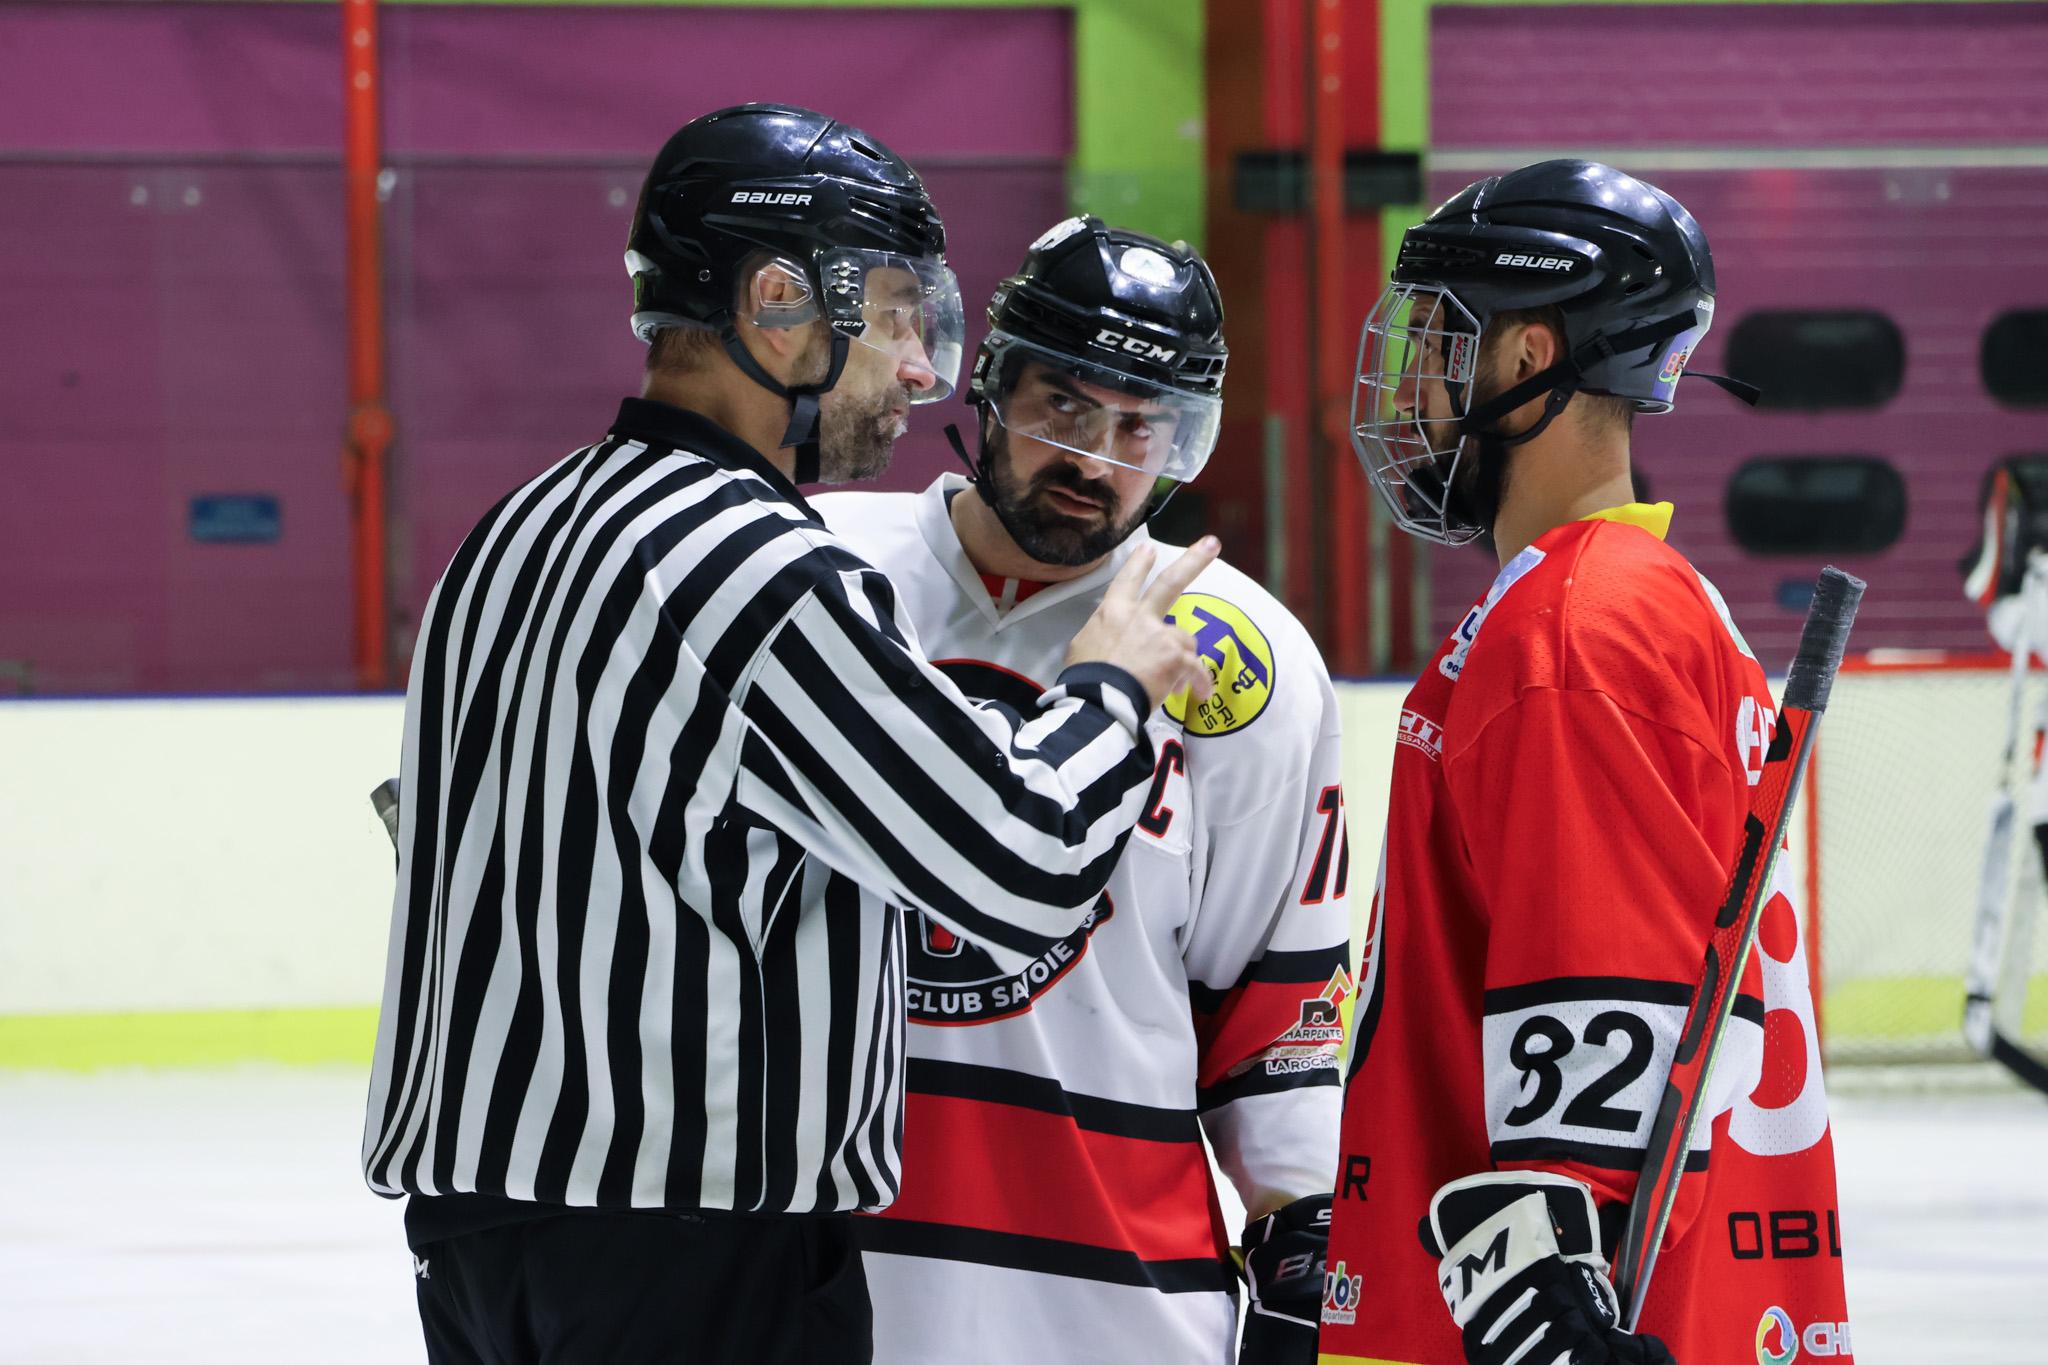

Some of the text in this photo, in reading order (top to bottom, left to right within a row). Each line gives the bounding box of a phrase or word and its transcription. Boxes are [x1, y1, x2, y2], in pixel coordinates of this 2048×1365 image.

[731, 192, 813, 206] BAUER
[1495, 254, 1575, 272] BAUER
[1096, 328, 1176, 363] CCM
[907, 988, 983, 1015] CLUB
[1504, 1010, 1654, 1133] 82
[1337, 1153, 1371, 1201] R
[1803, 1322, 1852, 1356] CH
